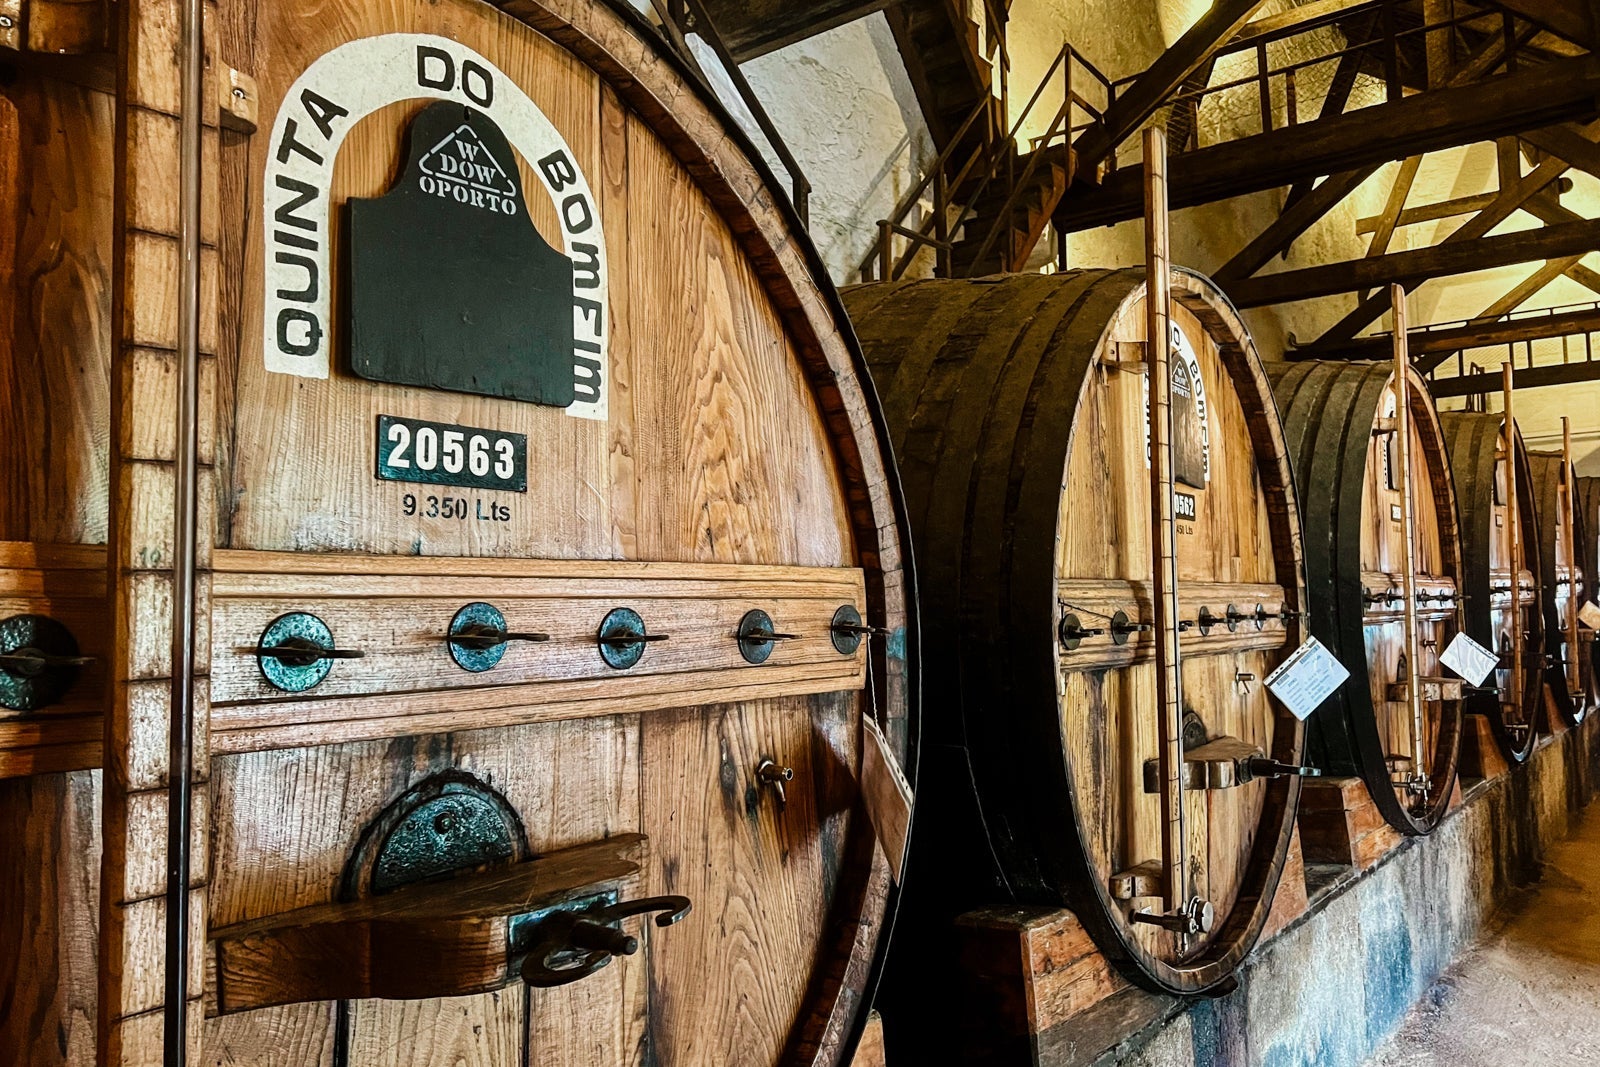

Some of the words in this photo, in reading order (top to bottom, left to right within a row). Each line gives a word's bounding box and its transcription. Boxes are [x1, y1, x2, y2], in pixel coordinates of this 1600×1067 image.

[455, 139, 480, 162] W
[439, 152, 497, 185] DOW
[274, 88, 349, 357] QUINTA
[417, 45, 493, 108] DO
[419, 175, 517, 215] OPORTO
[387, 423, 514, 480] 20563
[402, 493, 468, 520] 9.350
[476, 498, 511, 522] Lts
[1175, 494, 1195, 517] 0562
